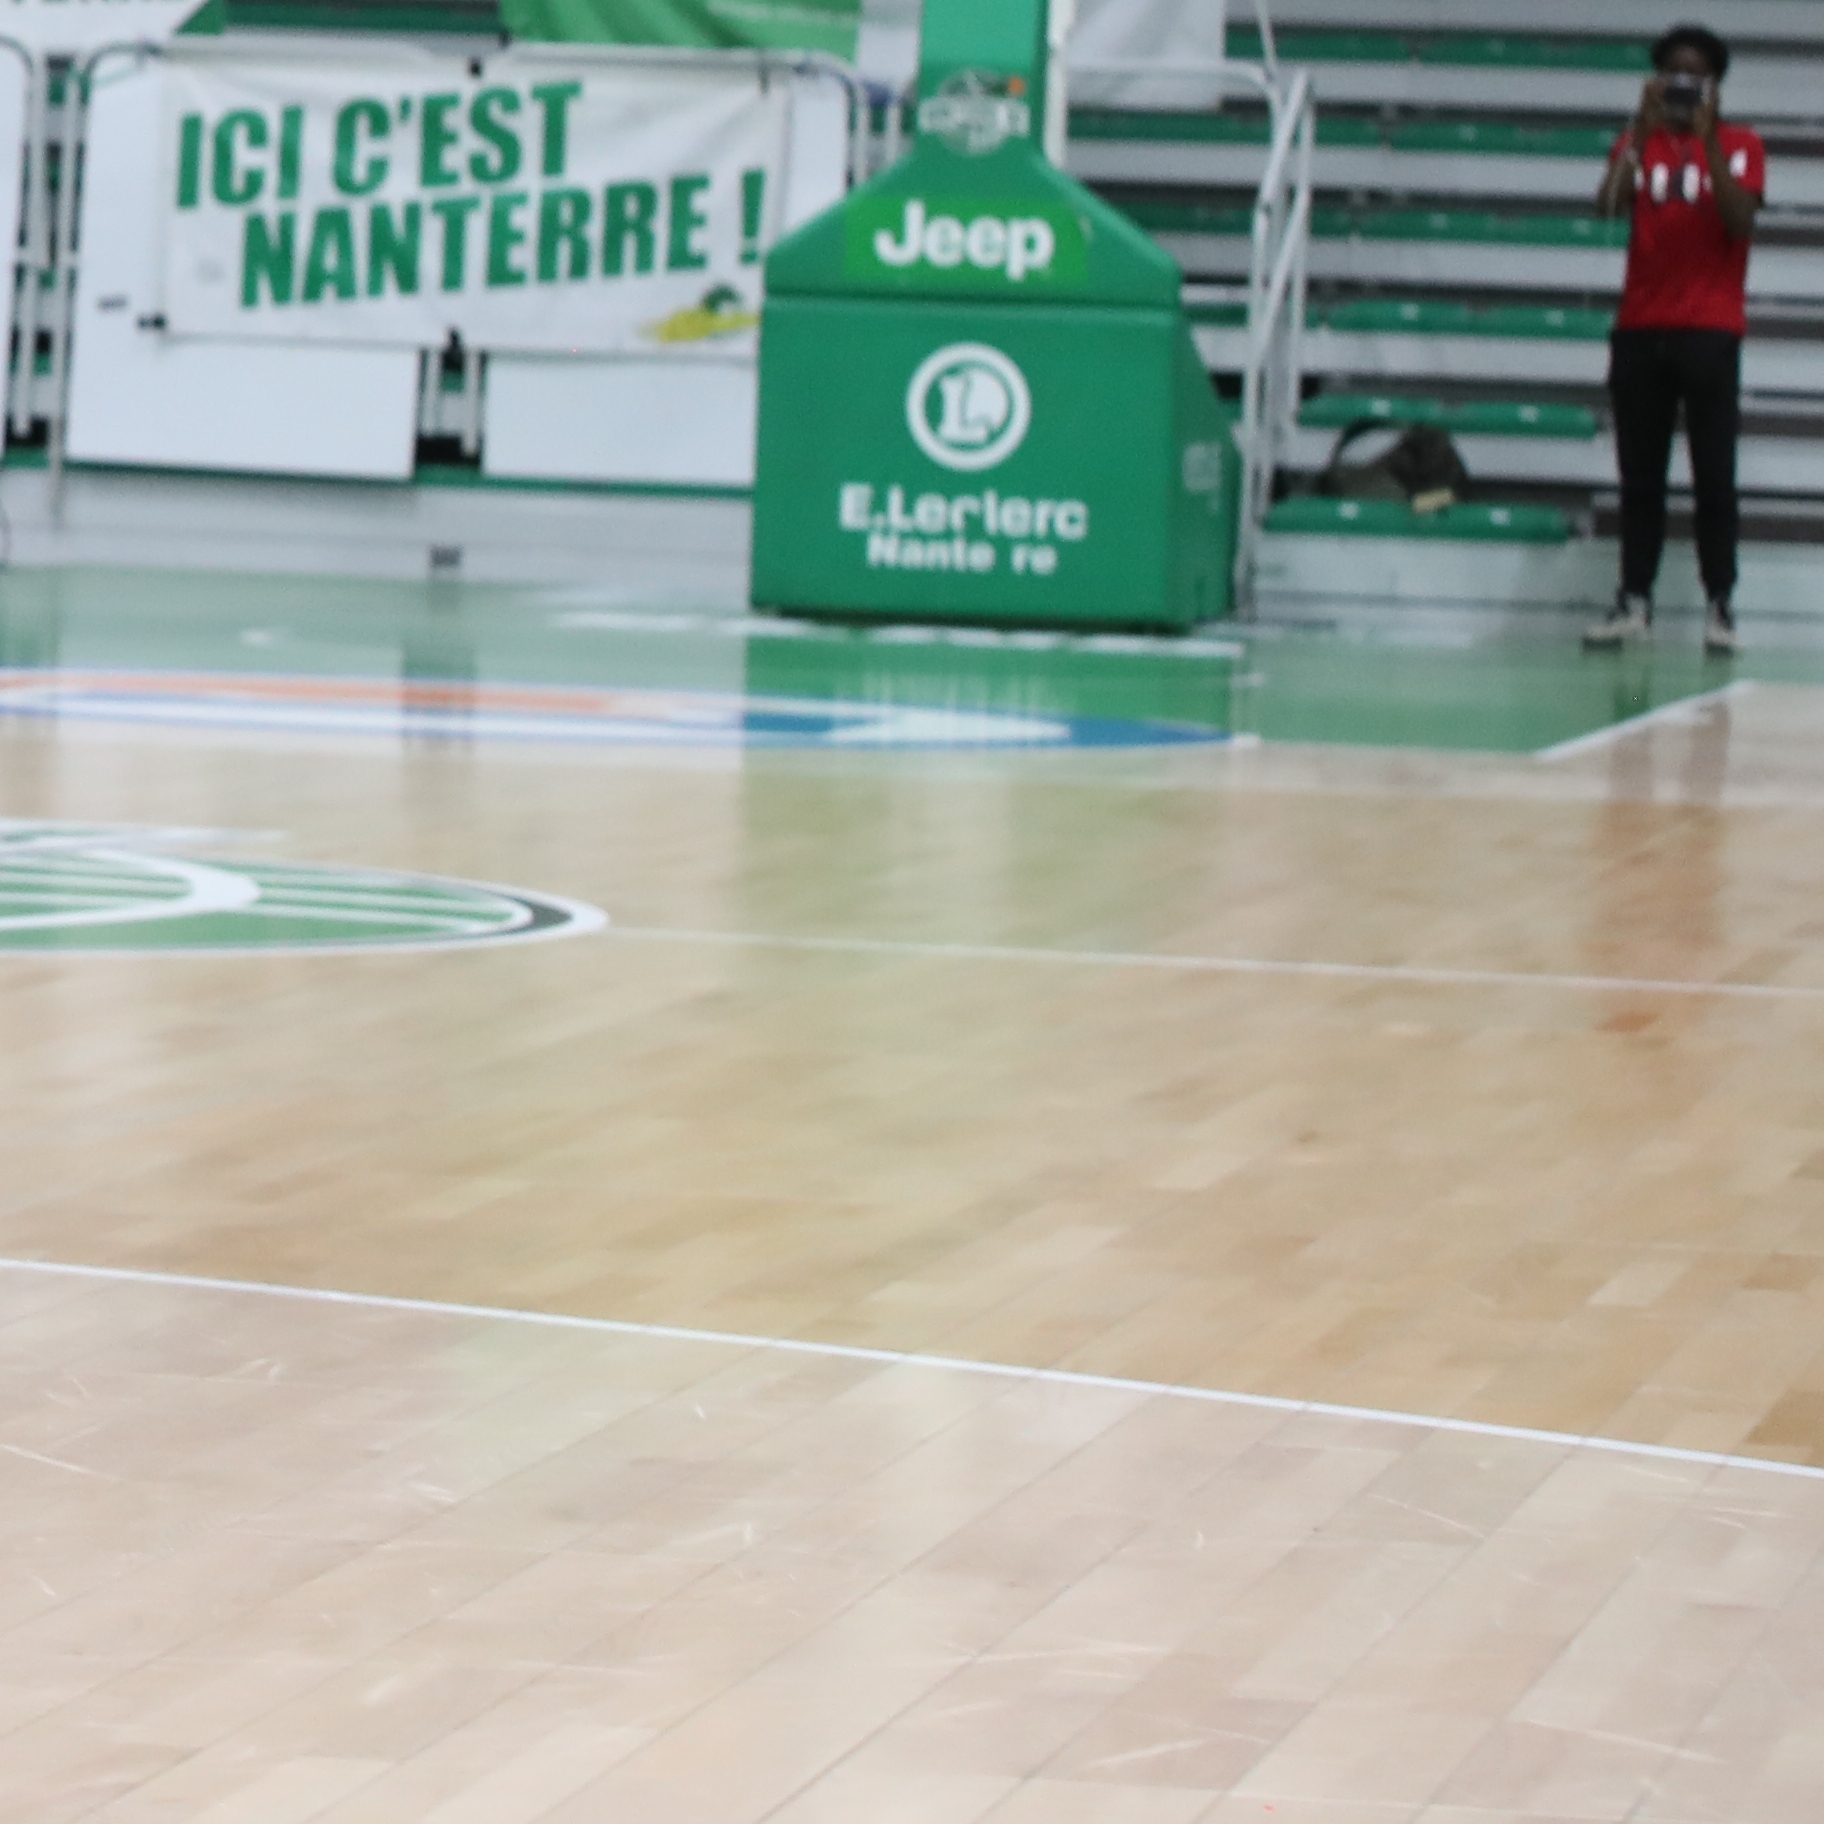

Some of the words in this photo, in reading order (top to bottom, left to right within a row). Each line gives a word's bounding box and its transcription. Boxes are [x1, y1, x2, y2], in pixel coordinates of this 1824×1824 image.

[177, 104, 303, 210] ICI
[333, 77, 583, 197] C'EST
[240, 172, 711, 308] NANTERRE
[873, 200, 1056, 281] Jeep
